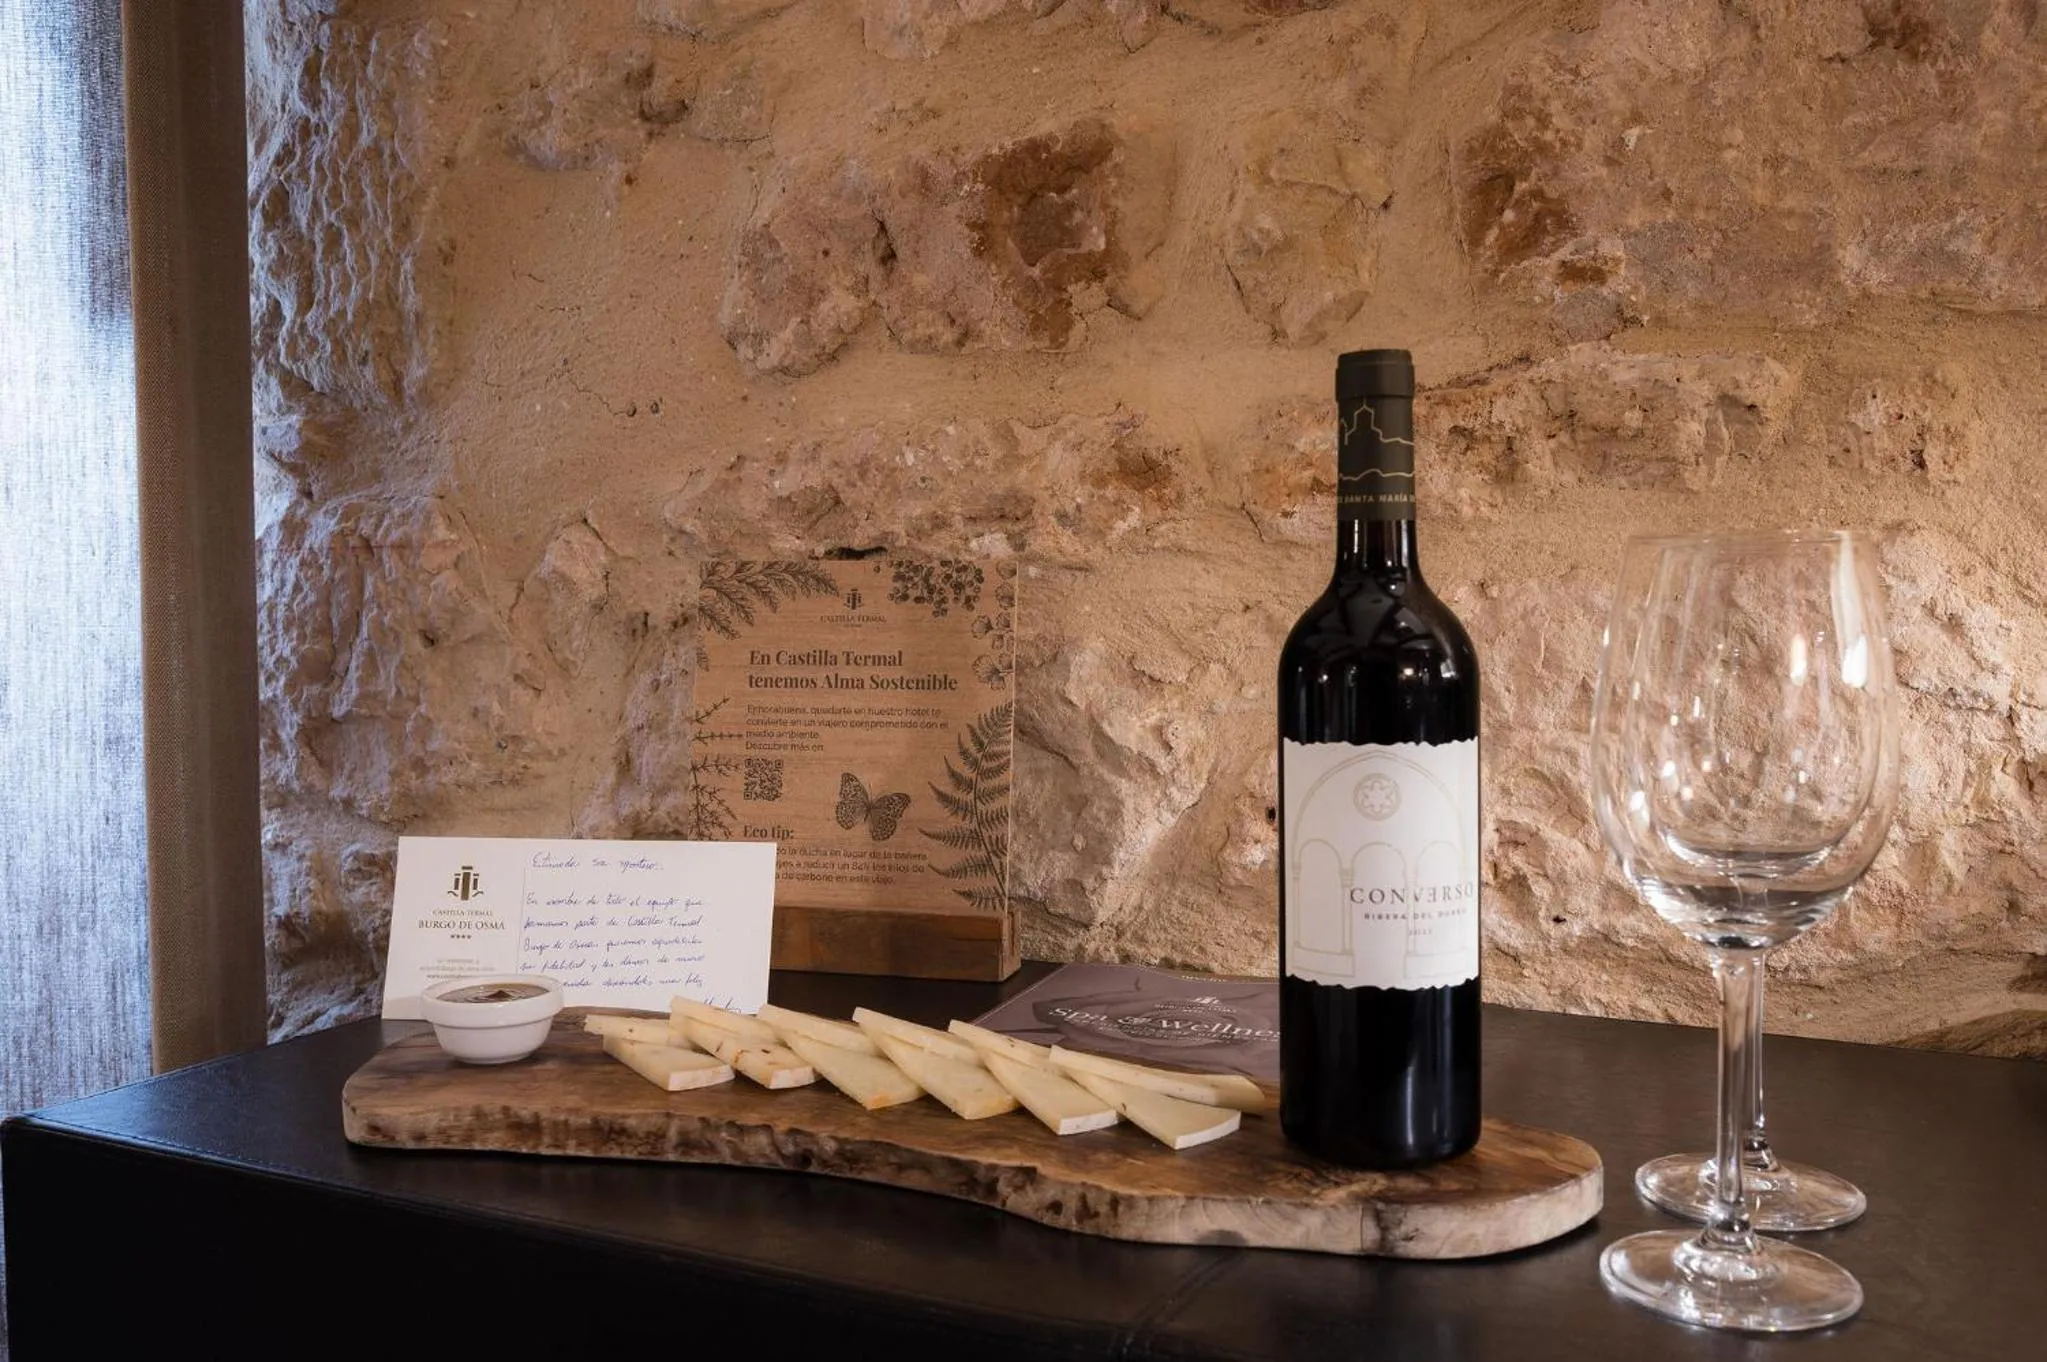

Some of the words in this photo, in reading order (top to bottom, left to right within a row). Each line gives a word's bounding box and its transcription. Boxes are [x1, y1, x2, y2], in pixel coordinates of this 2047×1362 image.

[751, 650, 771, 665] En
[776, 650, 838, 666] Castilla
[842, 650, 903, 667] Termal
[749, 674, 818, 689] tenemos
[821, 674, 865, 689] Alma
[869, 674, 958, 691] Sostenible
[811, 705, 851, 716] quedarte
[855, 707, 865, 715] en
[868, 706, 902, 716] nuestro
[905, 707, 930, 717] hotel
[820, 718, 848, 729] viajero
[850, 719, 918, 731] comprometido
[921, 721, 937, 729] con
[746, 730, 773, 739] medio
[776, 730, 819, 740] ambiente
[746, 741, 788, 751] Descubre
[744, 824, 767, 838] Eco
[771, 825, 794, 841] tip:
[1350, 882, 1474, 905] CONVERSO
[432, 909, 465, 917] CASTILLA
[1364, 911, 1407, 921] RIBERA
[1413, 911, 1433, 920] DEL
[418, 919, 456, 929] BURGO
[459, 920, 474, 930] DE
[475, 920, 505, 930] OSMA
